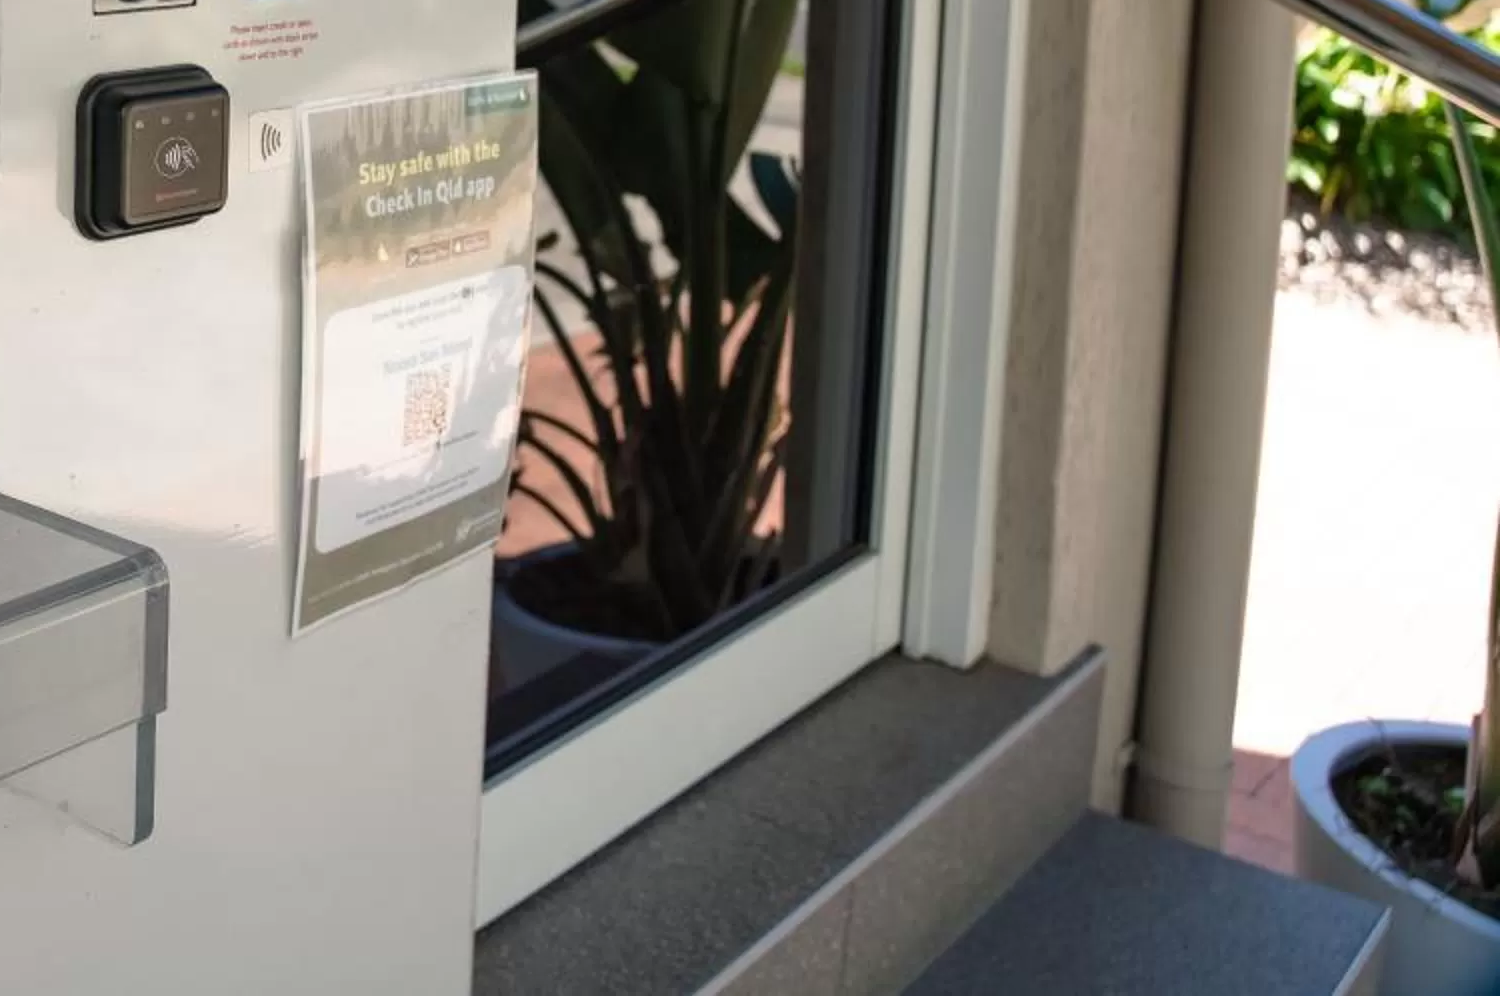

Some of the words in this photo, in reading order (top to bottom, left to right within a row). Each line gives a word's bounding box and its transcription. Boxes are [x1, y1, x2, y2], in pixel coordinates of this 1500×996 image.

[359, 162, 397, 186] Stay
[399, 149, 434, 177] safe
[435, 143, 472, 169] with
[472, 139, 500, 163] the
[364, 187, 415, 218] Check
[417, 185, 433, 207] In
[435, 175, 464, 205] Qld
[466, 175, 496, 201] app
